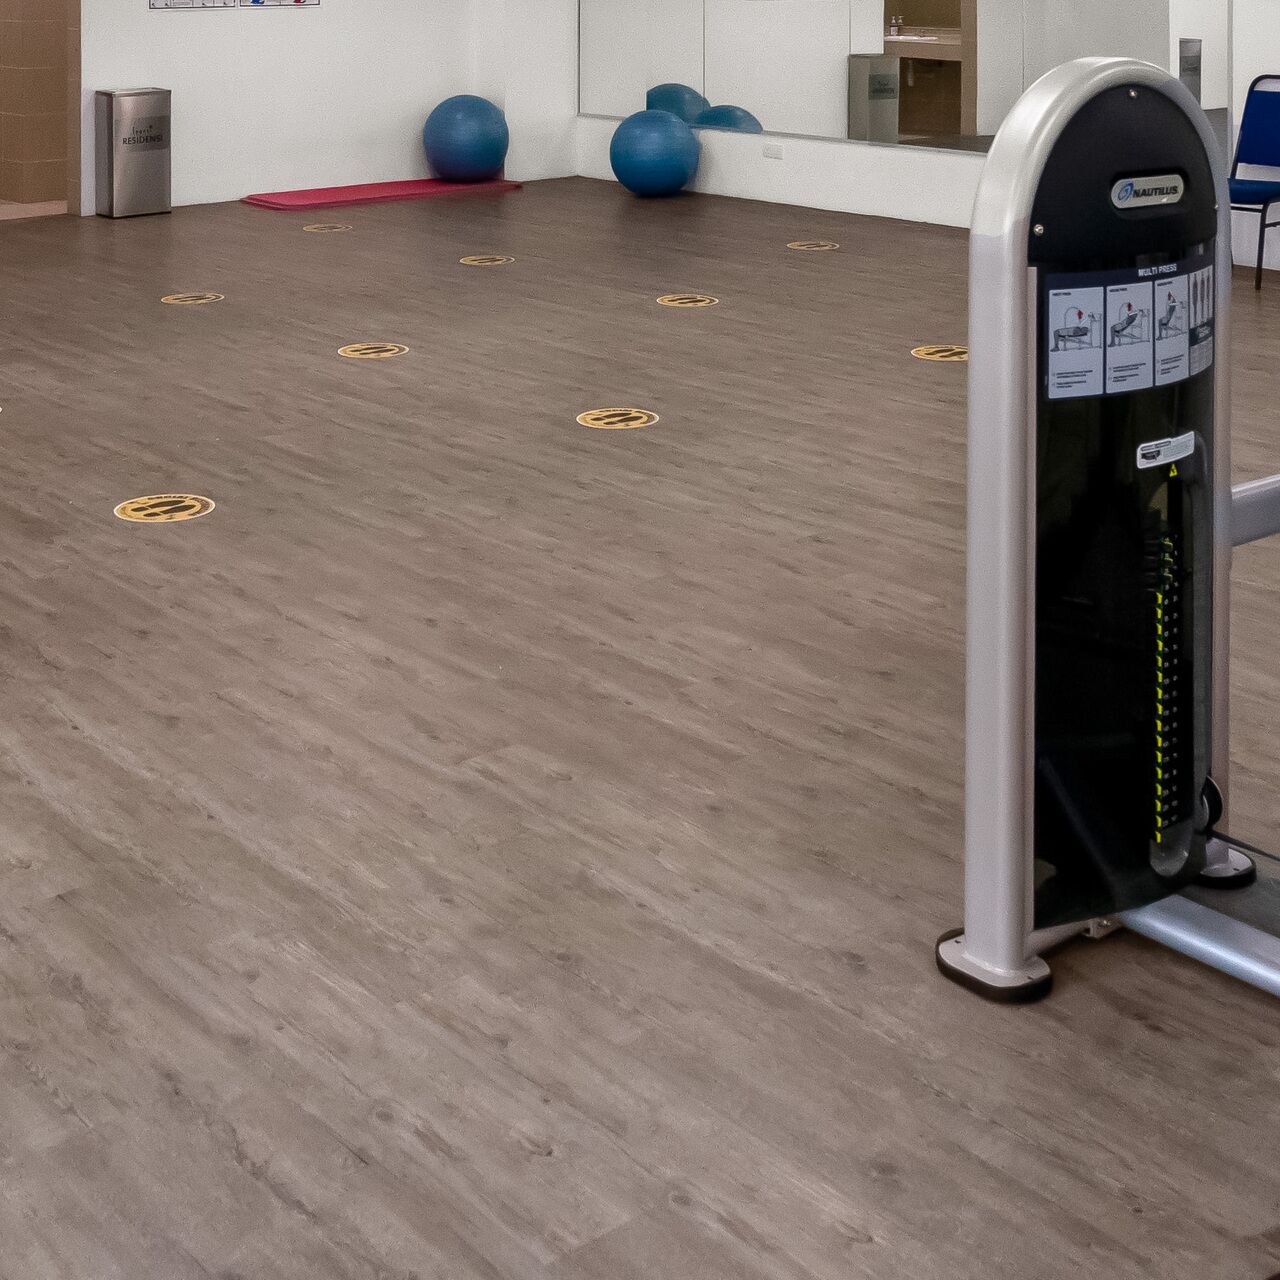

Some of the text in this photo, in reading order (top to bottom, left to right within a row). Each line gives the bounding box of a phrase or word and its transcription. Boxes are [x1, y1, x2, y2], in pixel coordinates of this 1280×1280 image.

[122, 134, 163, 145] RESIDENSI
[1133, 185, 1179, 198] NAUTILUS
[1138, 263, 1177, 277] MULTI PRESS
